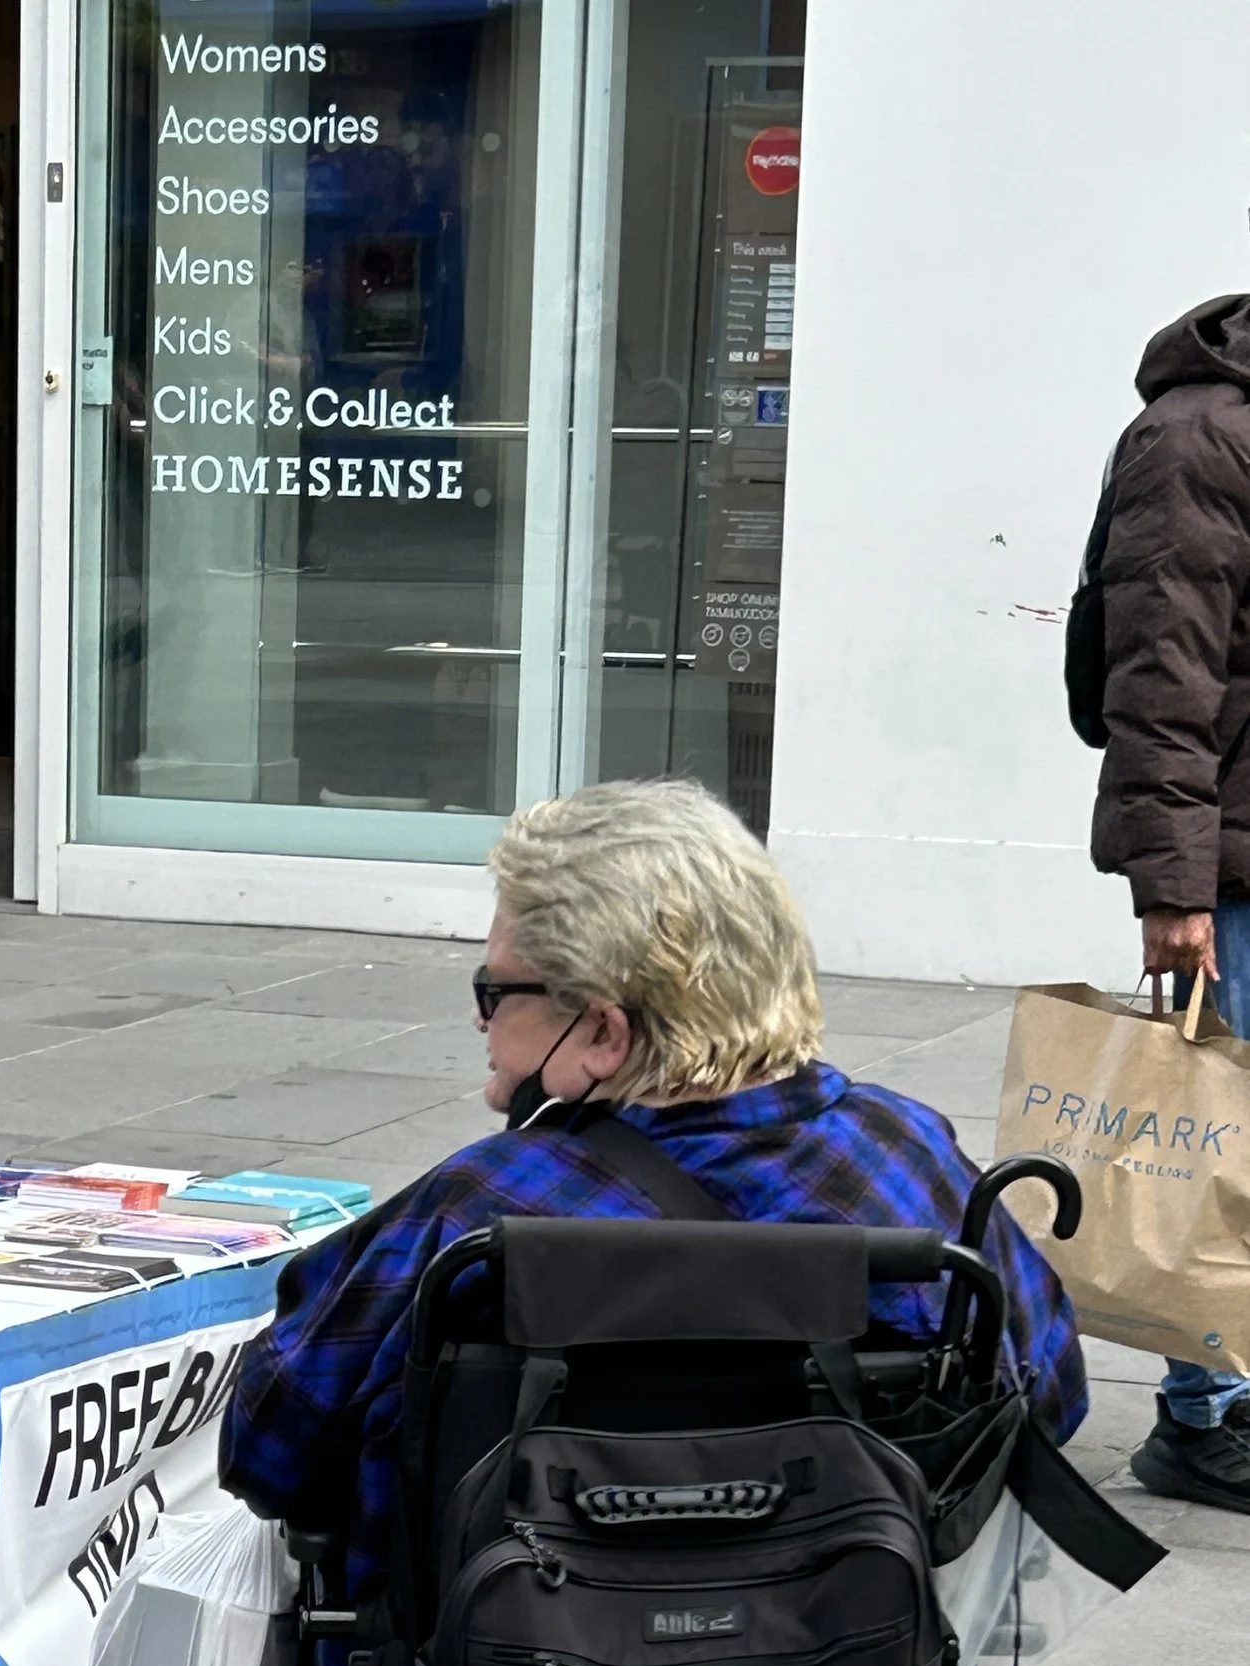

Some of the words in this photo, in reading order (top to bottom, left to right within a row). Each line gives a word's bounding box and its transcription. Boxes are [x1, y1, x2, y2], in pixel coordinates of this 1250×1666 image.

[160, 33, 326, 74] Womens
[158, 103, 379, 145] Accessories
[157, 176, 269, 215] Shoes
[155, 246, 254, 285] Mens
[154, 316, 231, 355] Kids
[153, 385, 255, 425] Click
[268, 387, 293, 426] &
[306, 387, 454, 428] Collect
[151, 455, 462, 499] HOMESENSE
[1022, 1084, 1231, 1156] PRIMARK
[34, 1362, 170, 1507] FREE
